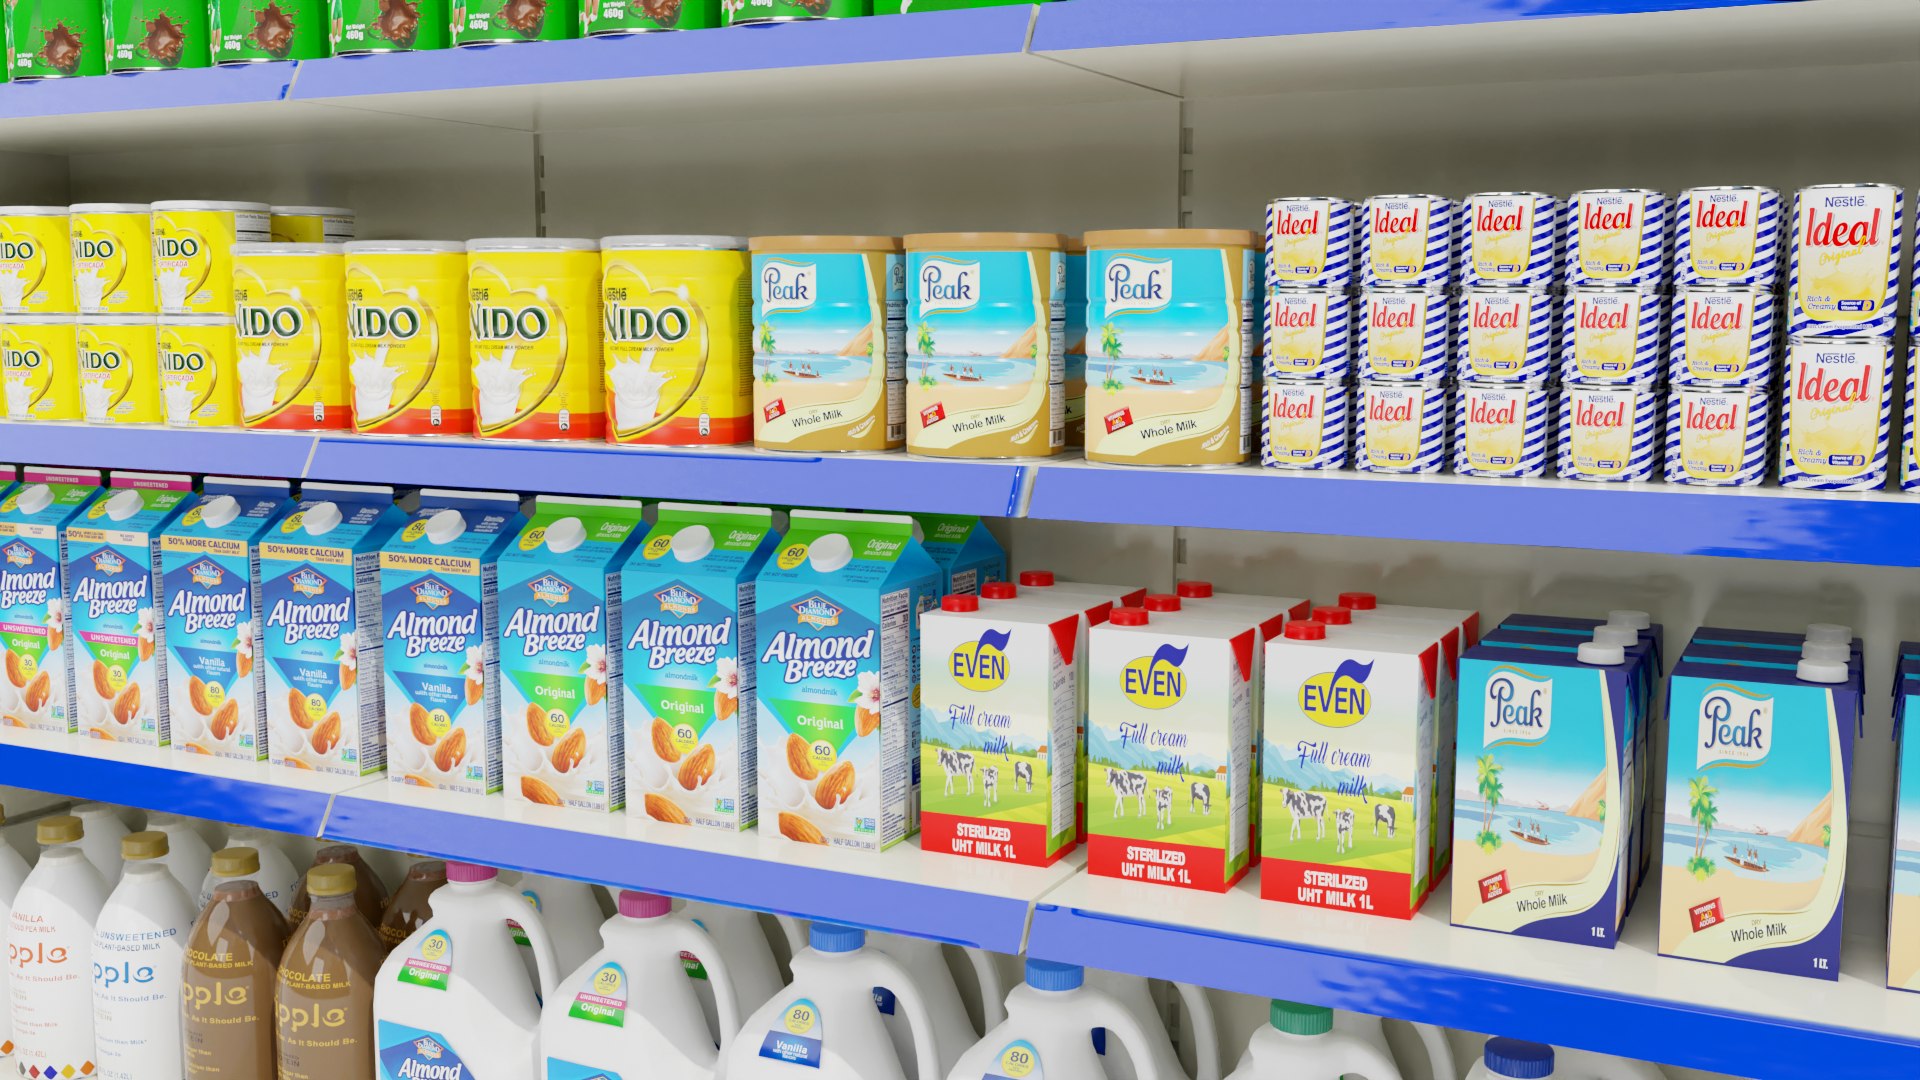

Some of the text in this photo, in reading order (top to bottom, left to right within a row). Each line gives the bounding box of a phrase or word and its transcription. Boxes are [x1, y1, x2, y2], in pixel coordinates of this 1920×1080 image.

[604, 8, 624, 20] 460g
[470, 19, 489, 30] 460g
[346, 30, 365, 42] 460g
[224, 41, 242, 51] 460g
[117, 51, 133, 61] 460g
[1277, 210, 1319, 235] Ideal
[1374, 208, 1419, 233] Ideal
[1477, 205, 1524, 232] Ideal
[1584, 202, 1634, 230] Ideal
[1696, 200, 1748, 228] Ideal
[1805, 207, 1881, 248] Ideal
[764, 267, 809, 303] Peak
[922, 265, 973, 303] Peak
[1108, 263, 1164, 303] Peak
[471, 304, 548, 340] NIDO
[606, 304, 690, 341] NIDO
[1275, 302, 1317, 328] Ideal
[1372, 302, 1416, 328] Ideal
[1473, 302, 1520, 329] Ideal
[1580, 302, 1630, 330] Ideal
[1691, 302, 1743, 330] Ideal
[1797, 362, 1871, 402] Ideal
[1273, 393, 1315, 419] Ideal
[1369, 395, 1413, 421] Ideal
[1470, 397, 1518, 424] Ideal
[1576, 399, 1625, 427] Ideal
[792, 409, 844, 428] Whole Milk
[953, 414, 1006, 433] Whole Milk
[1686, 401, 1738, 431] Ideal
[1140, 419, 1199, 440] Whole Milk
[168, 537, 240, 551] 50% MORE CALCIUM
[530, 531, 545, 543] 60
[653, 537, 667, 549] 60
[728, 530, 760, 542] Original
[267, 545, 345, 561] 50% MORE CALCIUM
[787, 547, 805, 560] 60
[867, 540, 901, 552] Original
[388, 554, 472, 571] 50% MORE CALCIUM
[73, 575, 148, 602] Almond
[417, 588, 448, 598] DIAMOND
[424, 582, 440, 590] BLUE
[534, 584, 568, 594] DIAMOND
[543, 579, 560, 588] BLUE
[1, 590, 46, 609] Breeze
[167, 588, 247, 616] Almond
[662, 596, 698, 606] DIAMOND
[669, 589, 689, 598] BLUE
[88, 599, 138, 618] Breeze
[266, 596, 352, 627] Almond
[799, 607, 838, 617] DIAMOND
[808, 600, 828, 610] BLUE
[3, 624, 47, 635] UNSWEETENED
[184, 612, 237, 634] Breeze
[386, 606, 478, 640] Almond
[502, 604, 601, 639] Almond
[90, 633, 137, 645] UNSWEETENED
[284, 622, 340, 645] Breeze
[627, 616, 733, 652] Almond
[12, 638, 40, 650] Original
[405, 633, 466, 658] Breeze
[522, 631, 587, 657] Breeze
[760, 629, 875, 665] Almond
[25, 659, 33, 667] 30
[100, 649, 131, 660] Original
[199, 655, 226, 667] Vanilla
[538, 660, 570, 668] almondmilk
[647, 644, 717, 672] Breeze
[952, 646, 1006, 681] EVEN
[299, 667, 328, 680] Vanilla
[665, 671, 699, 682] almondmilk
[784, 657, 858, 687] Breeze
[1124, 662, 1182, 698] EVEN
[210, 686, 220, 694] 80
[421, 681, 452, 695] Vanilla
[535, 689, 576, 704] Original
[801, 685, 838, 696] almondmilk
[1303, 678, 1366, 716] EVEN
[311, 698, 322, 706] 80
[660, 702, 705, 718] Original
[1489, 677, 1544, 728] Peak
[434, 713, 446, 723] 80
[551, 713, 565, 724] 60
[796, 714, 845, 732] Original
[948, 703, 1012, 730] Full cream
[1703, 696, 1764, 749] Peak
[677, 728, 692, 739] 60
[1119, 720, 1188, 748] Full cream
[814, 747, 831, 760] 60
[983, 736, 1009, 762] milk
[1297, 740, 1373, 768] Full cream
[1156, 754, 1185, 783] milk
[1337, 774, 1369, 805] milk
[956, 822, 1011, 842] STERILIZED
[951, 838, 1017, 859] UHT MILK 1L
[1126, 845, 1186, 866] STERILIZED
[1121, 862, 1192, 884] UHT MILK 1L
[1302, 869, 1369, 892] STERILIZED
[1297, 886, 1375, 911] UHT MILK 1L
[1516, 893, 1569, 914] Whole Milk
[1694, 902, 1717, 915] VITAMINS
[1700, 908, 1714, 921] A&D
[1699, 916, 1717, 929] ADDED
[101, 927, 178, 942] UNSWEETENED
[1731, 922, 1788, 943] Whole Milk
[143, 943, 161, 953] MILK
[430, 938, 443, 950] 30
[191, 960, 232, 970] PLANT-BASED
[408, 959, 448, 972] UNSWEETENED
[408, 967, 441, 981] Original
[286, 980, 352, 991] PLANT-BASED MILK
[601, 971, 618, 984] 30
[579, 993, 623, 1008] UNSWEETENED
[581, 1002, 616, 1017] Original
[209, 1015, 260, 1025] Should Be.
[793, 1008, 810, 1021] 80
[307, 1037, 358, 1048] Should Be.
[776, 1040, 809, 1055] Vanilla
[1009, 1051, 1029, 1064] 80
[397, 1057, 463, 1080] Almond
